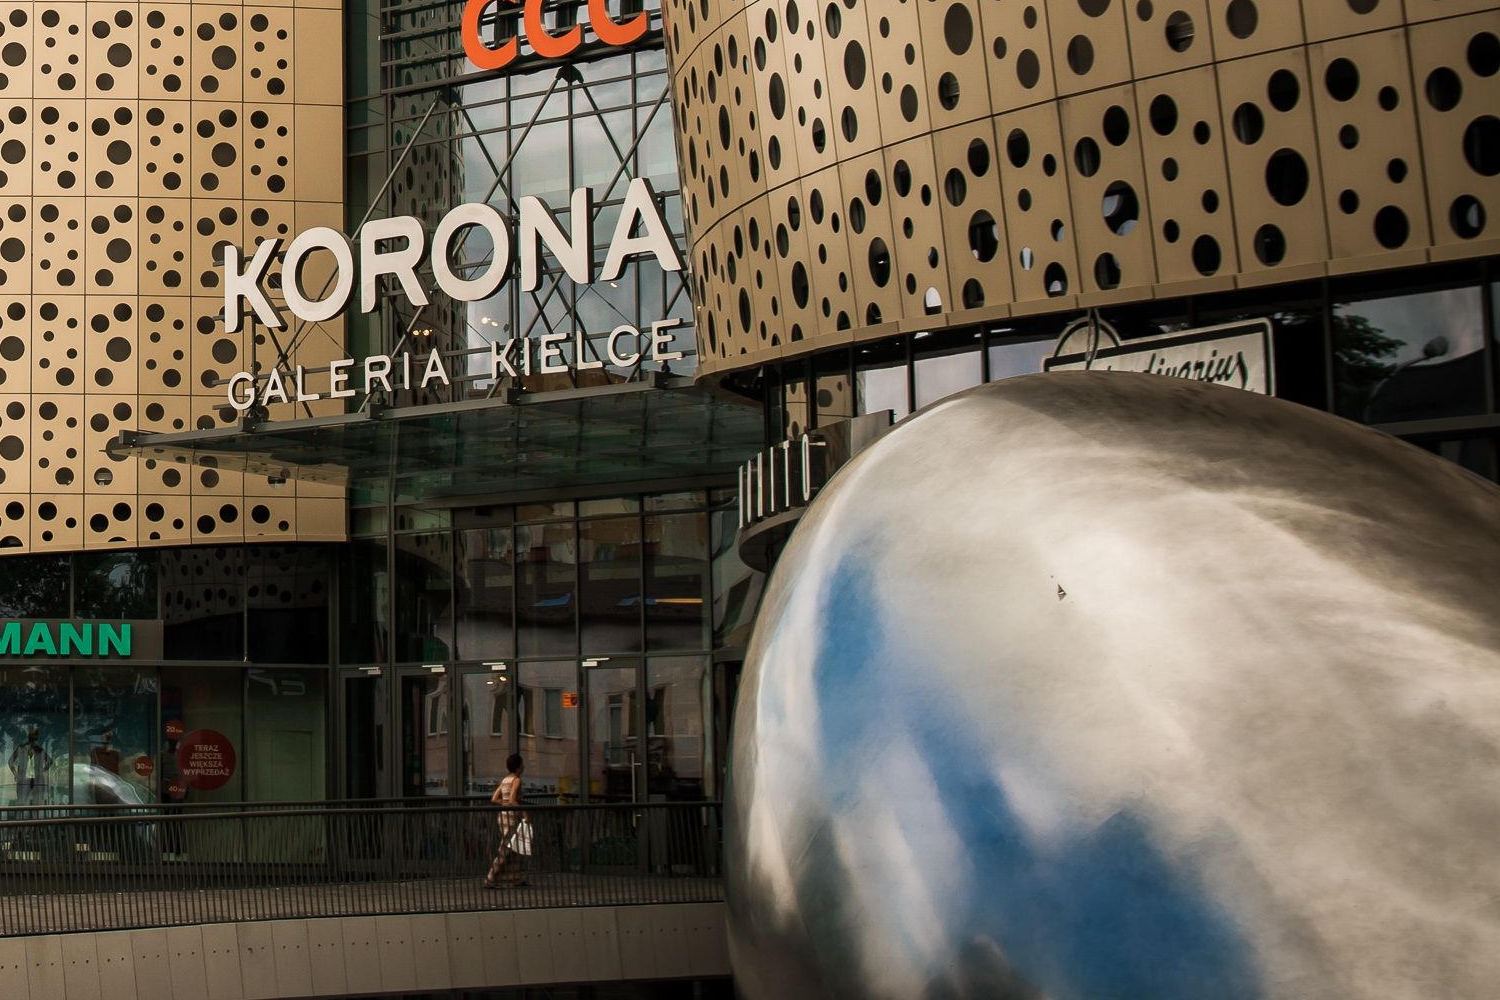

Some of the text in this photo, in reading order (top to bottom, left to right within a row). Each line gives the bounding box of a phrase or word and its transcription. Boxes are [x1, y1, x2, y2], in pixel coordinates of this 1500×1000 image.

[223, 177, 684, 334] KORONA
[227, 317, 684, 410] GALERIA KIELCE
